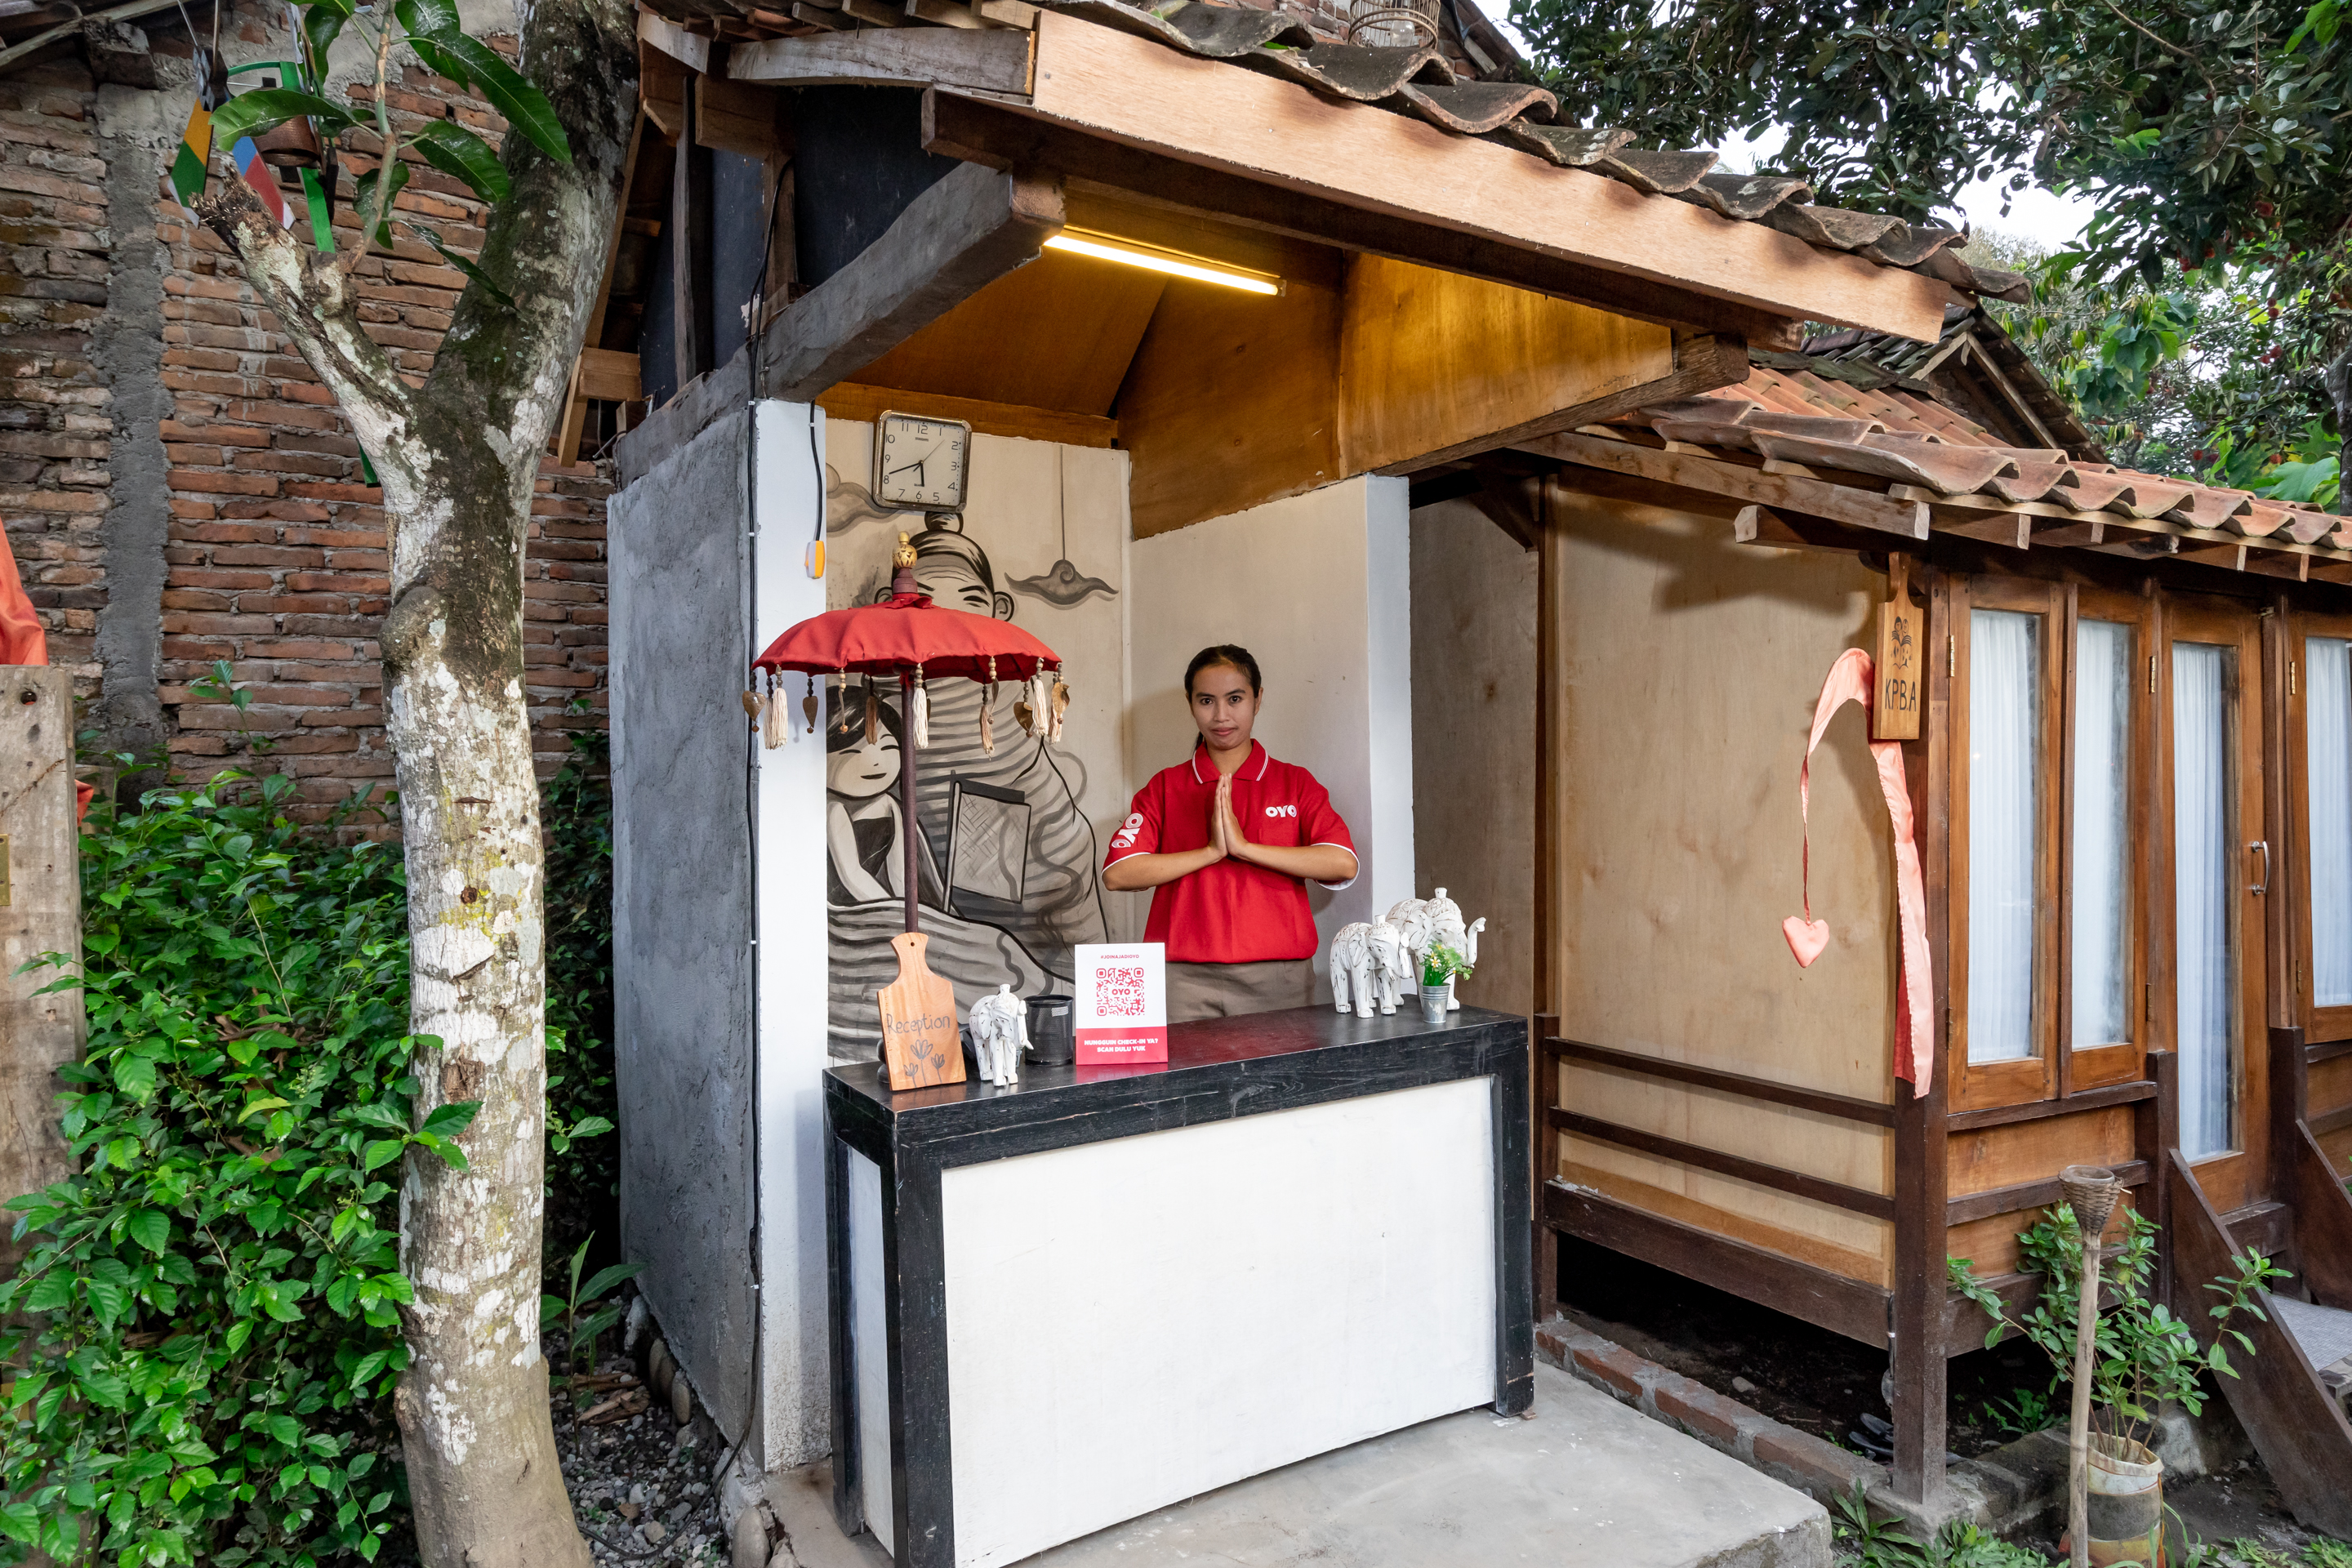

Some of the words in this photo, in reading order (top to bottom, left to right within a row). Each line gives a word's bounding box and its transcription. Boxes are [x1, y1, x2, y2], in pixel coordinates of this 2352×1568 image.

[902, 422, 909, 432] 11
[917, 424, 929, 434] 12
[885, 434, 896, 444] 10
[951, 441, 959, 450] 2
[884, 454, 891, 463] 9
[951, 461, 957, 471] 3
[883, 474, 889, 484] 8
[947, 481, 956, 491] 4
[898, 488, 906, 497] 7
[915, 491, 922, 500] 6
[933, 492, 940, 501] 5
[1265, 804, 1298, 818] OYO
[1111, 813, 1144, 849] OYO
[886, 1013, 951, 1036] Reception
